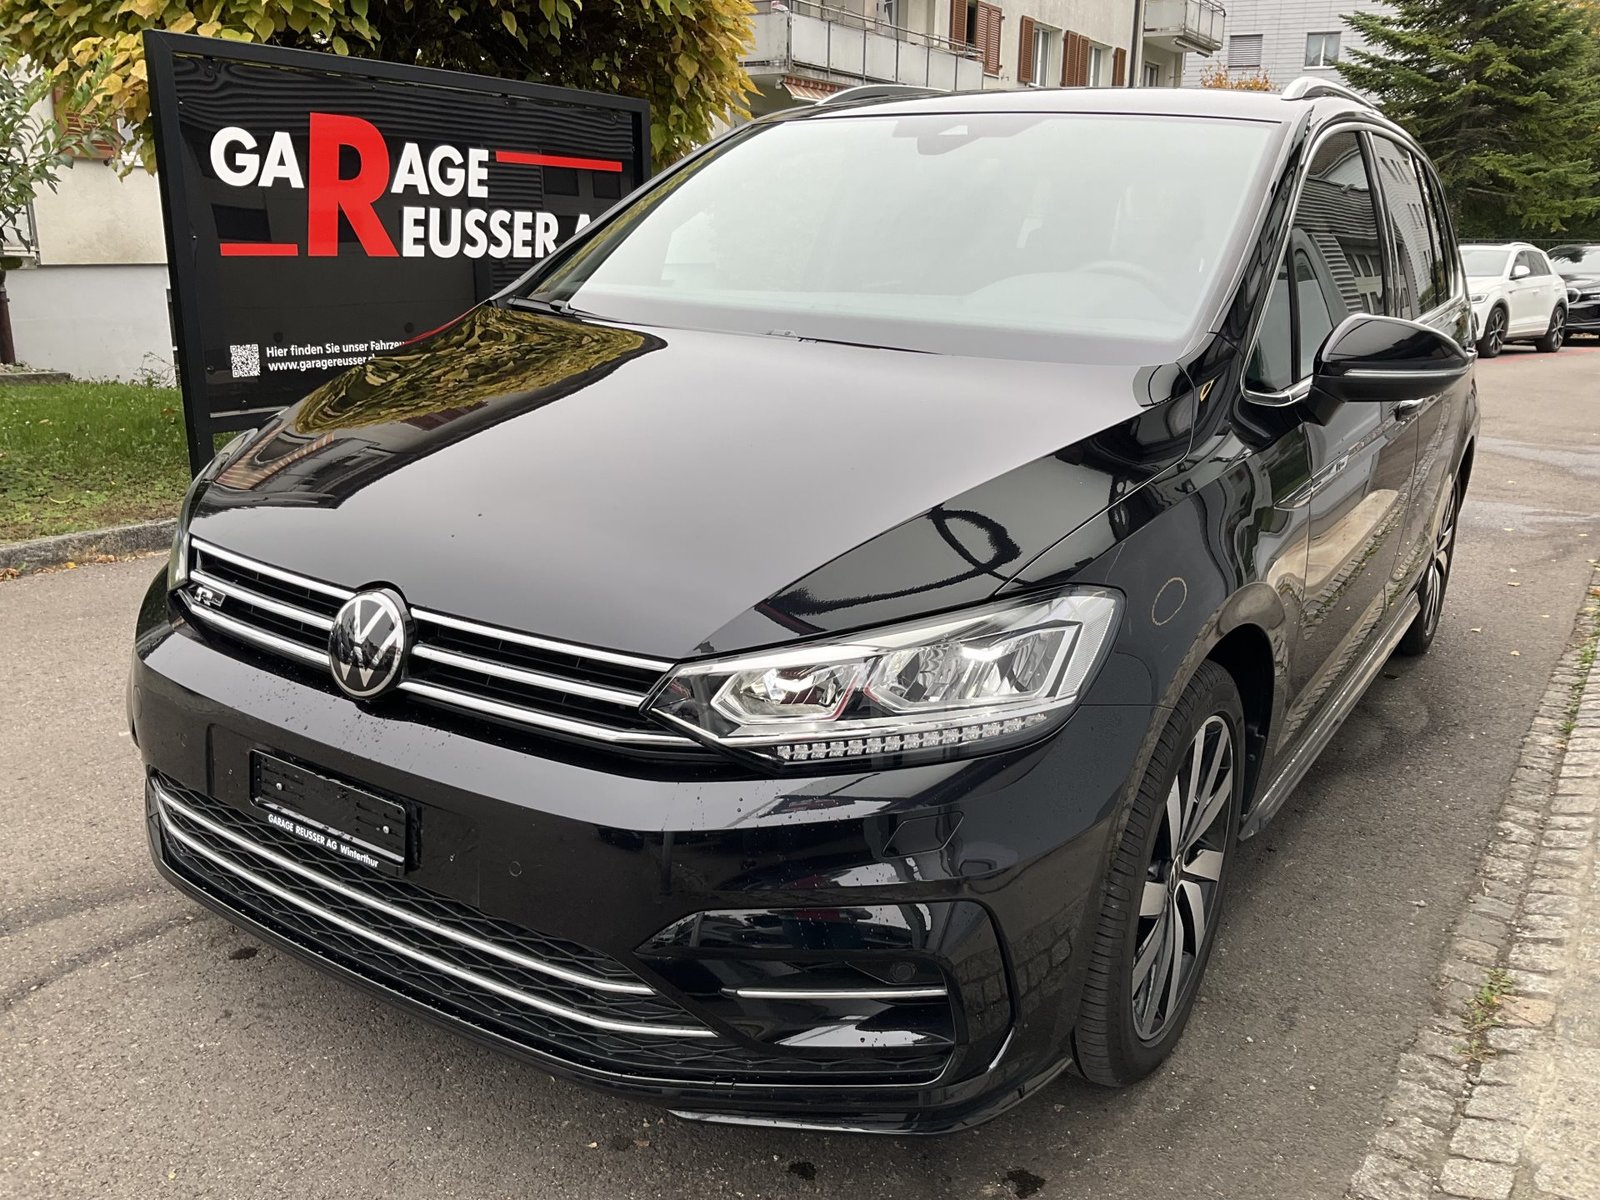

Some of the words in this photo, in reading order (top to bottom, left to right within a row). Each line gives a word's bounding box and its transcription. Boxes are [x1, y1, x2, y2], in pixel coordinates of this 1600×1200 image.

[209, 112, 489, 257] GARAGE
[266, 346, 288, 358] Hier
[290, 344, 323, 356] finden
[325, 343, 341, 354] Sie
[342, 343, 368, 353] unser
[268, 353, 375, 372] www.garagereusser
[268, 813, 294, 831] GARAGE
[295, 825, 325, 845] REUSSER
[326, 839, 337, 850] AG
[340, 844, 379, 868] Winterthur
